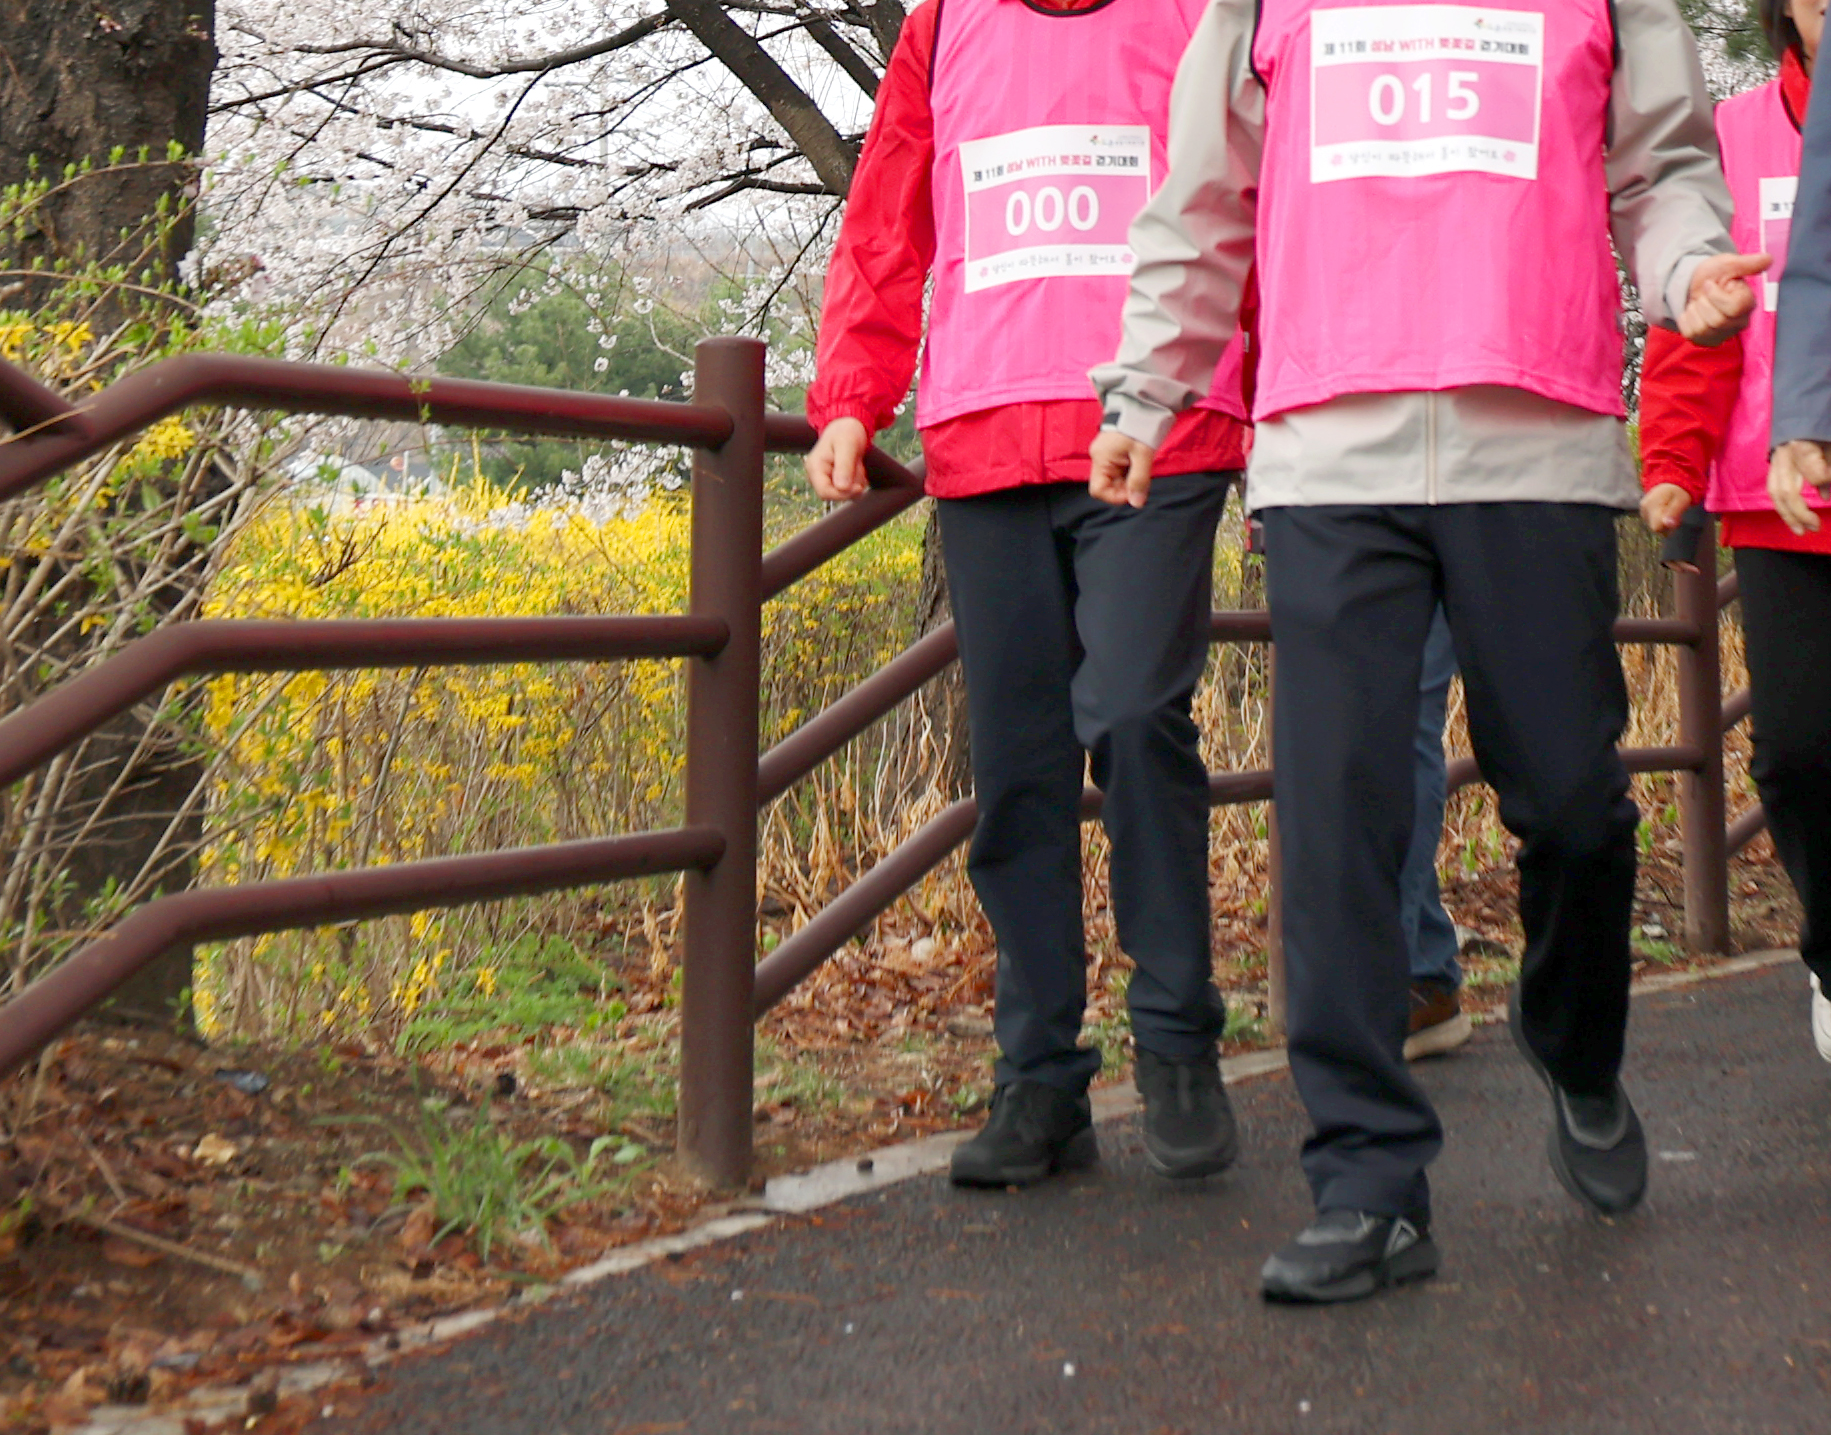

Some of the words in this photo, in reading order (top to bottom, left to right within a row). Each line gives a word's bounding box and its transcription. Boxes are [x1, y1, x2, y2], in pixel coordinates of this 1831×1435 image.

[1399, 38, 1434, 51] WITH
[1368, 70, 1481, 126] 015
[1026, 155, 1056, 169] WITH
[1005, 185, 1100, 236] 000
